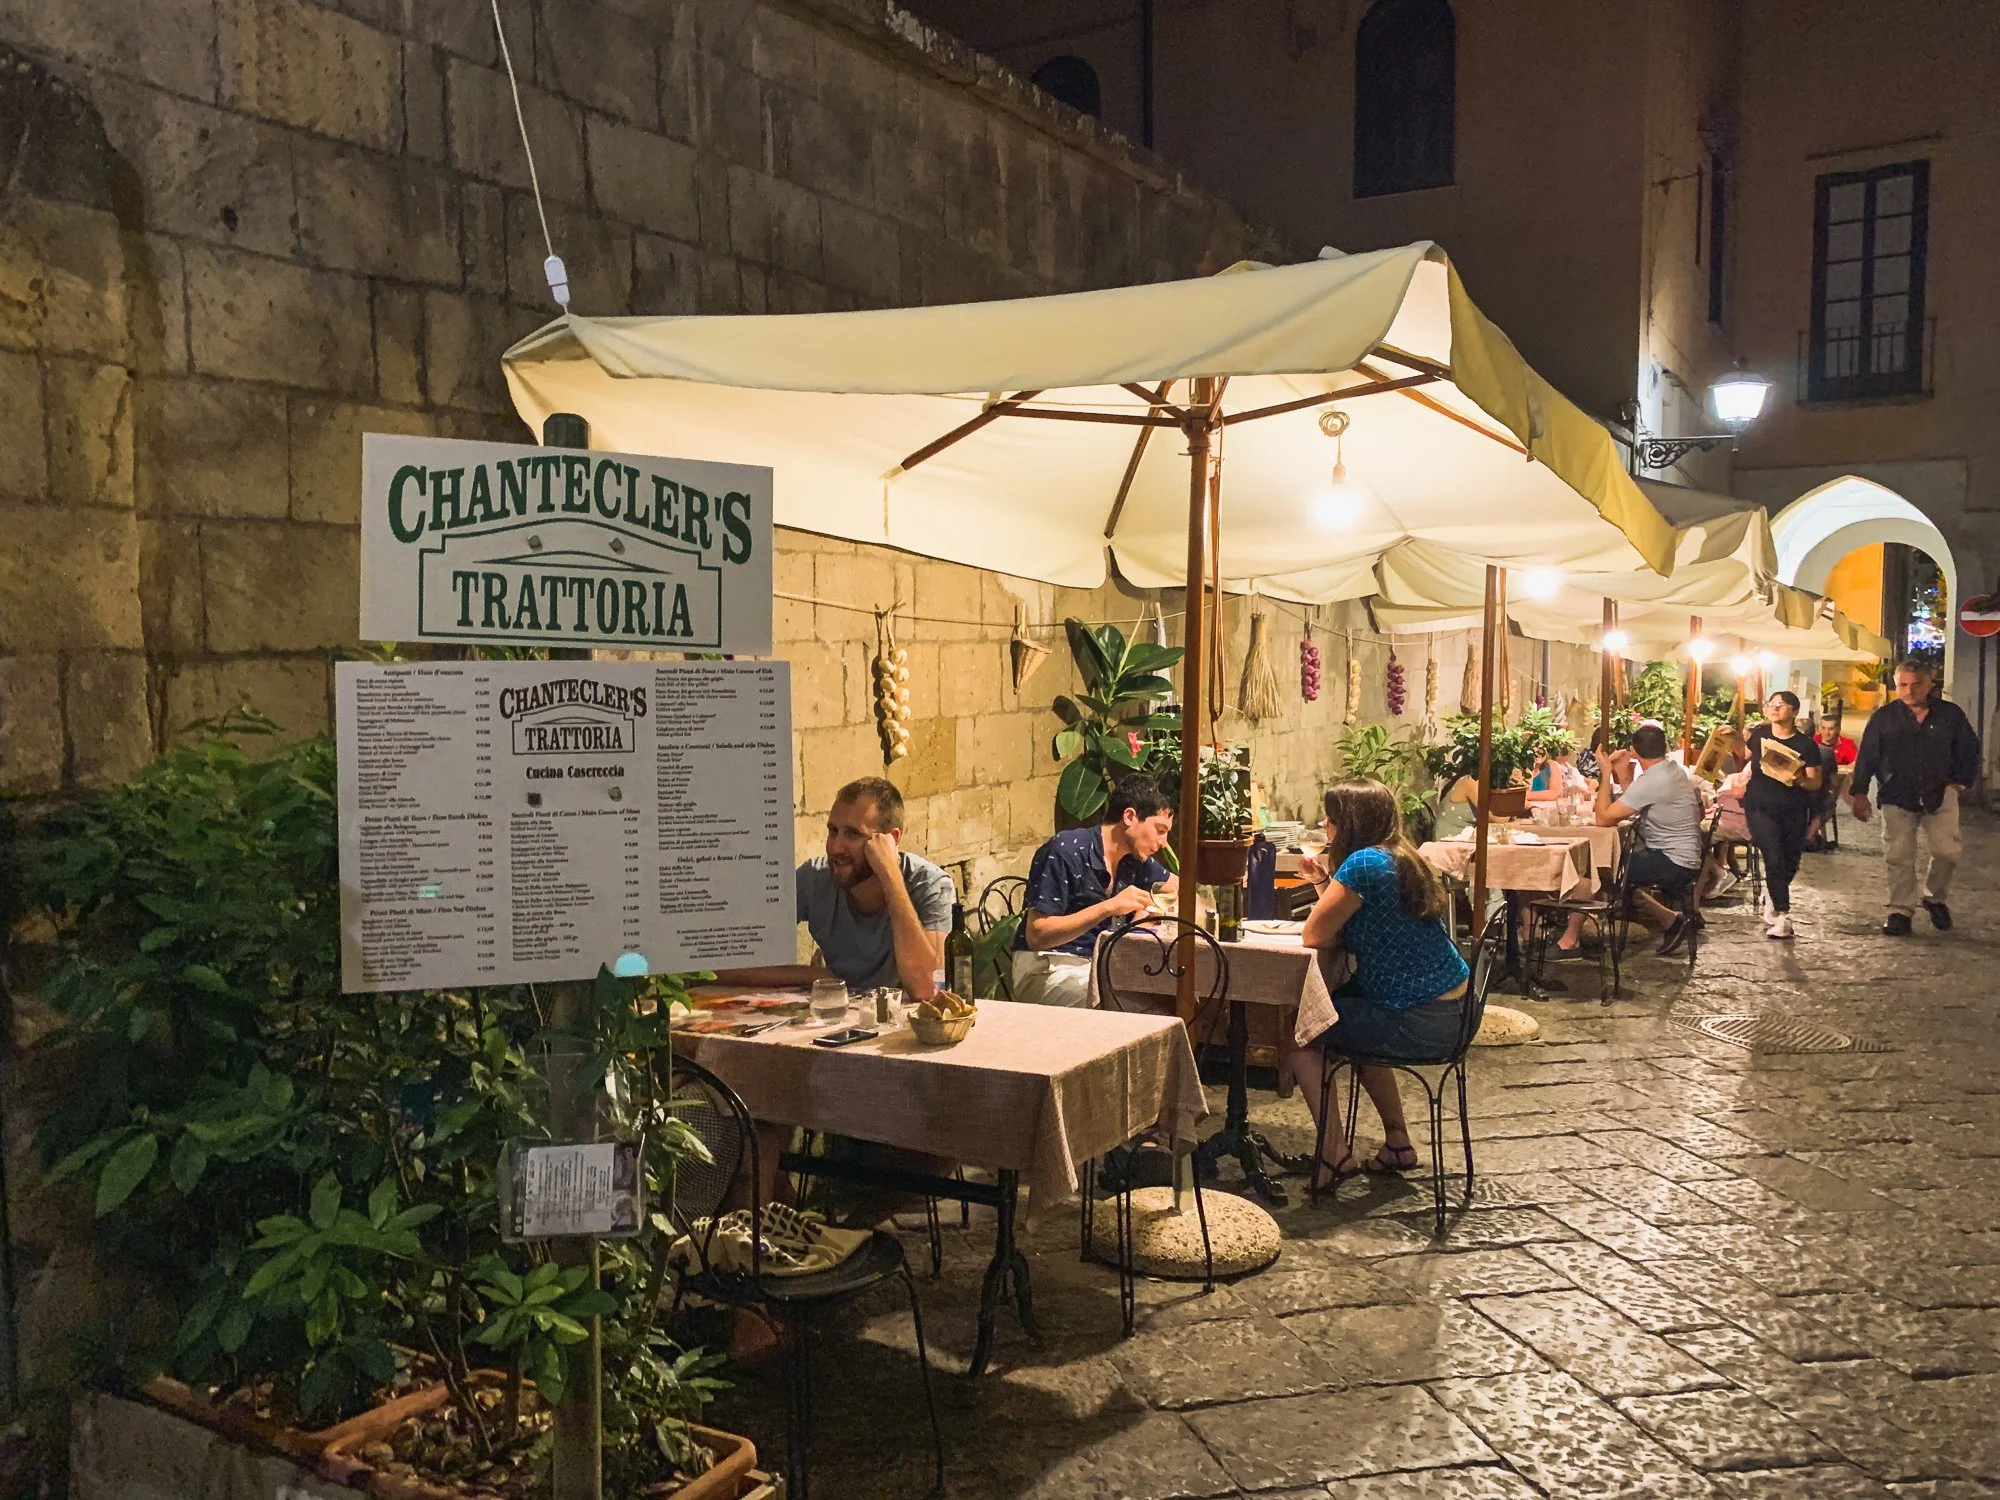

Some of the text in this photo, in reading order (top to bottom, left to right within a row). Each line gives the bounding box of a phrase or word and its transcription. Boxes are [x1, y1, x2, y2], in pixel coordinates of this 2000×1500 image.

[388, 455, 752, 565] CHANTECLER'S
[452, 570, 694, 638] TRATTORIA
[500, 679, 647, 719] CHANTECLER'S
[525, 727, 623, 751] TRATTORIA
[526, 765, 624, 779] Cucina Casereccia
